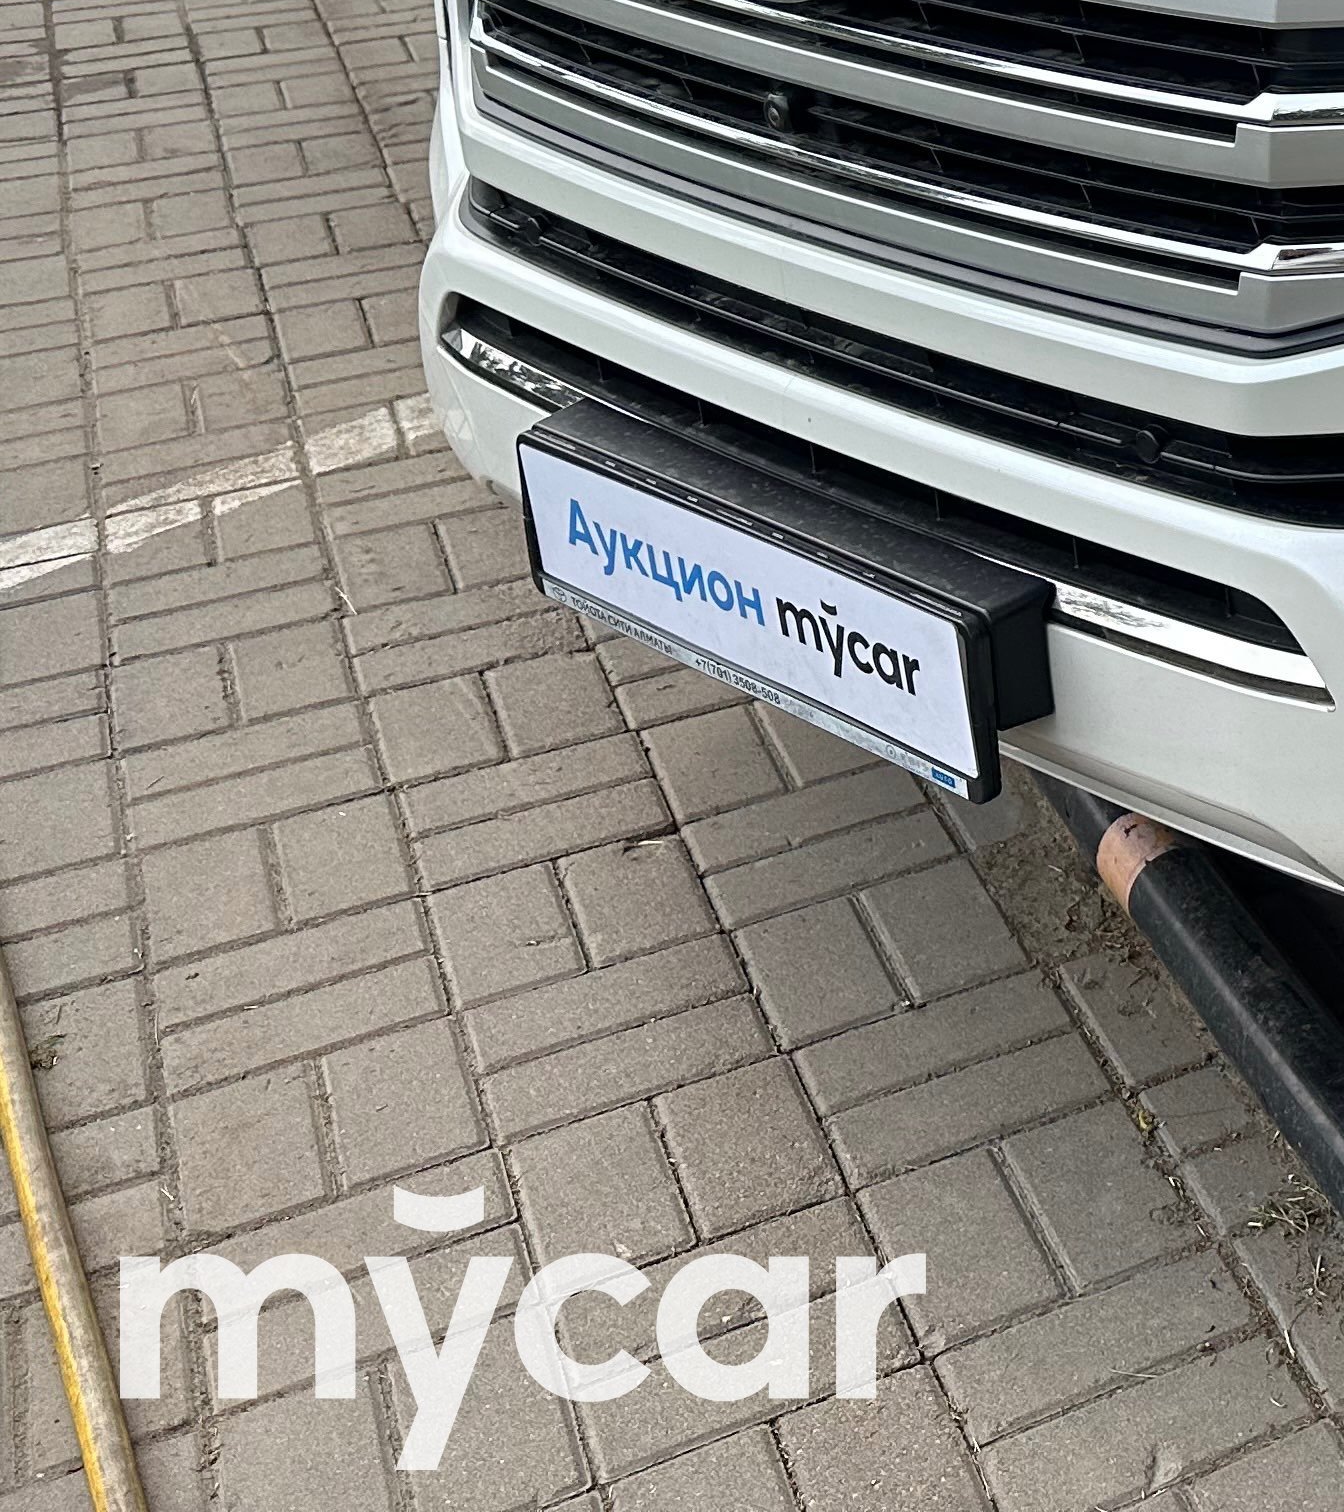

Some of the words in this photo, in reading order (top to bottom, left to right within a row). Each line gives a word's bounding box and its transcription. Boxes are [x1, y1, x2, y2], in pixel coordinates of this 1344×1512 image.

[569, 498, 766, 626] Аукцион
[570, 596, 607, 622] ТОЙОТА
[608, 615, 632, 635] СИТИ
[633, 627, 673, 655] АЛМАТЫ
